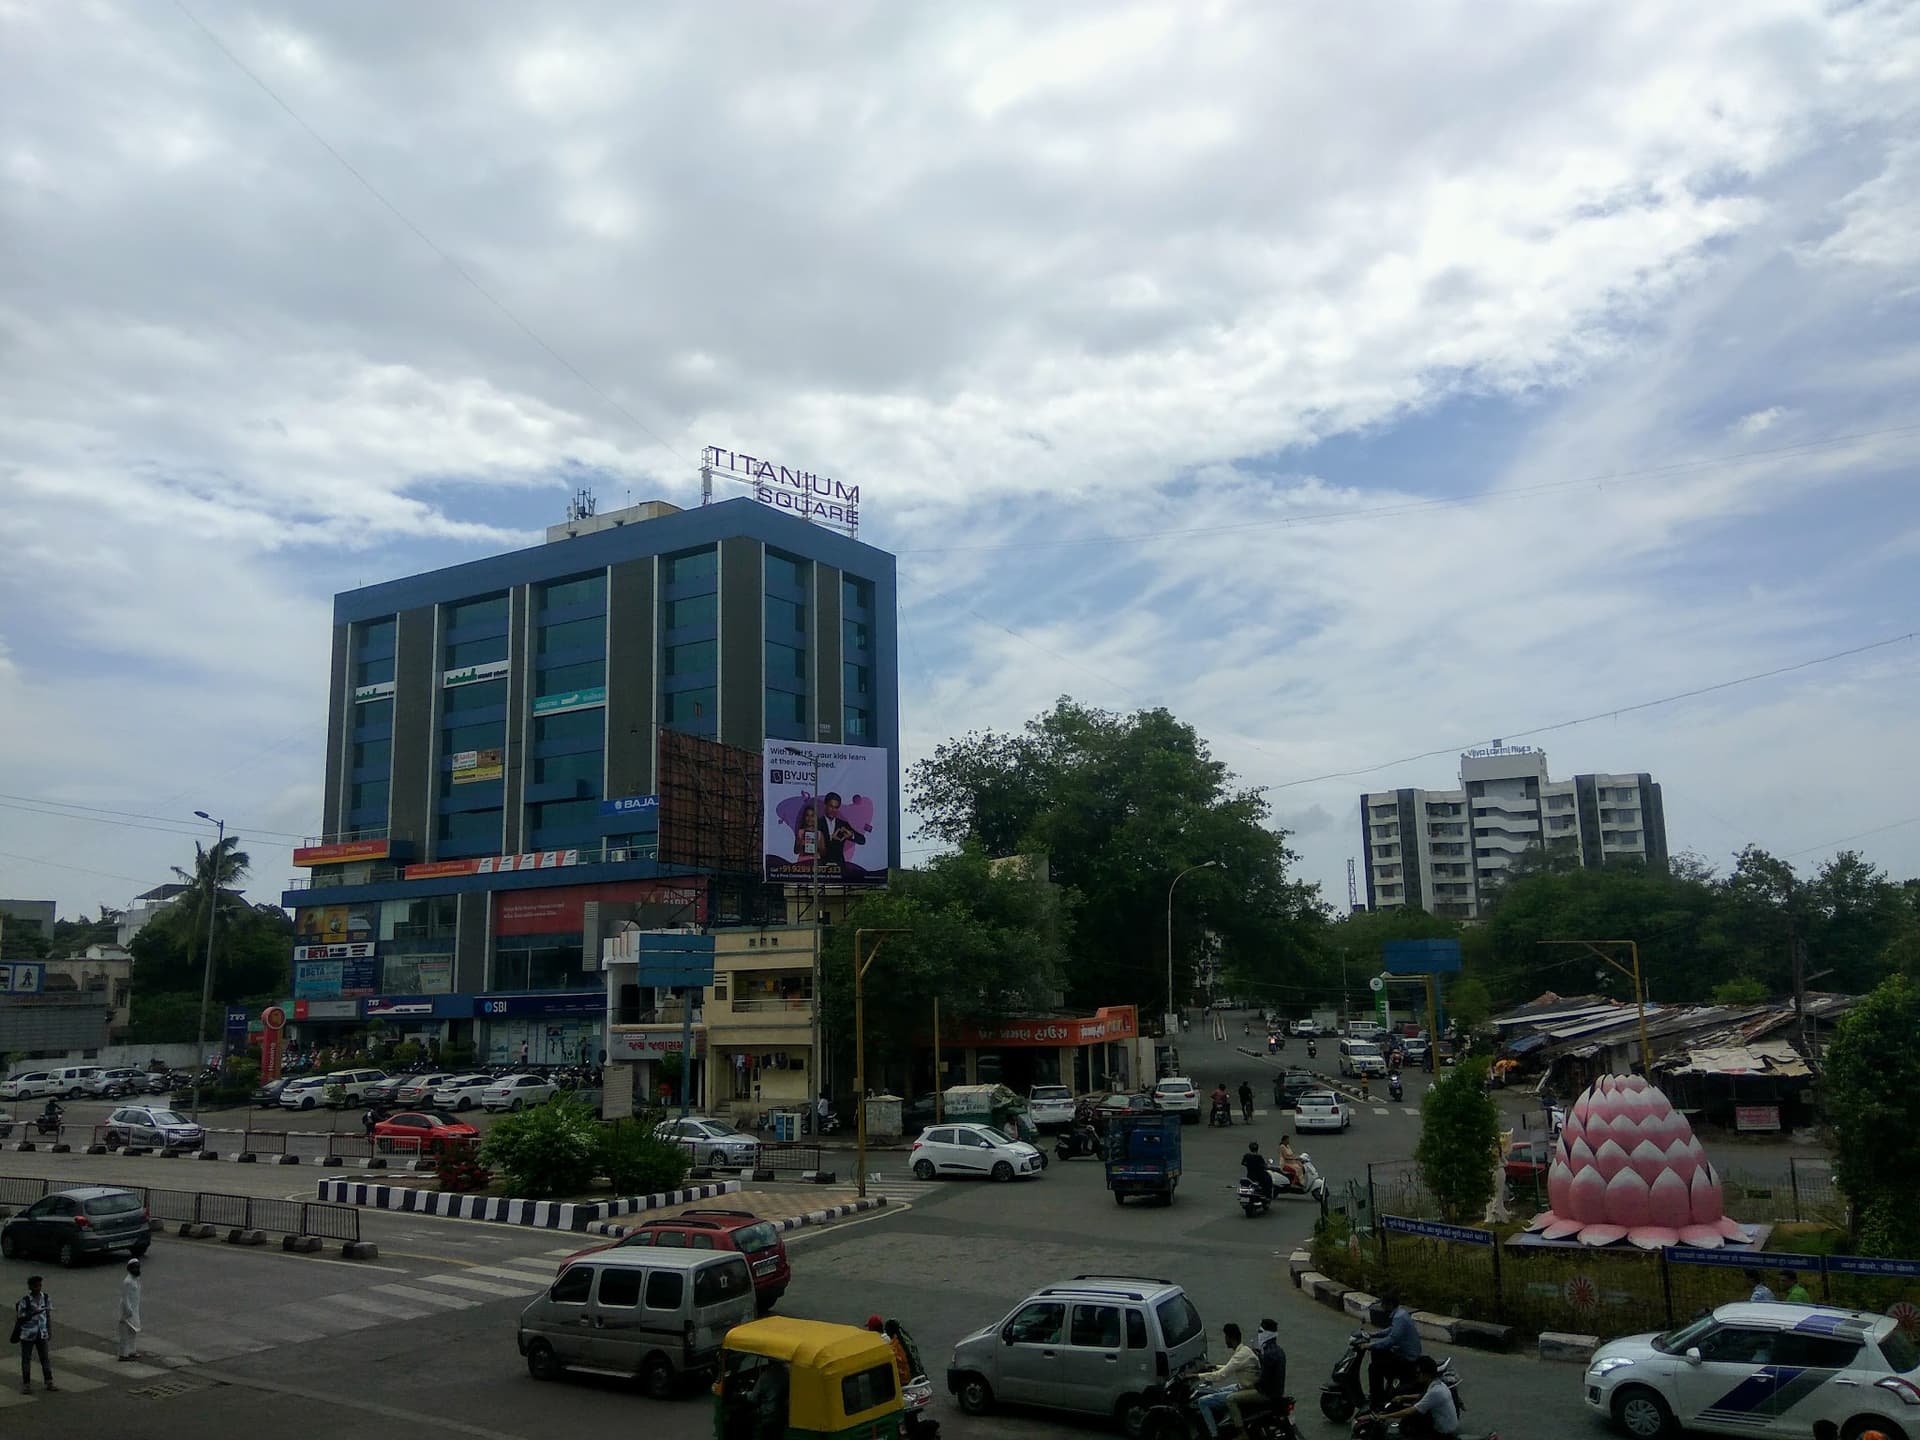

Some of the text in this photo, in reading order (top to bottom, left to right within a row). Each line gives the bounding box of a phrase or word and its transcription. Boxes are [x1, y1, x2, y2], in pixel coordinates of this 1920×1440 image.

[708, 445, 859, 503] TITANIUM
[757, 487, 859, 525] SQUARE
[833, 752, 847, 760] kids
[848, 753, 866, 761] learn
[784, 770, 816, 781] BYJU'S
[624, 797, 659, 809] BAJA
[308, 948, 329, 959] BETA
[492, 1001, 508, 1013] SBI
